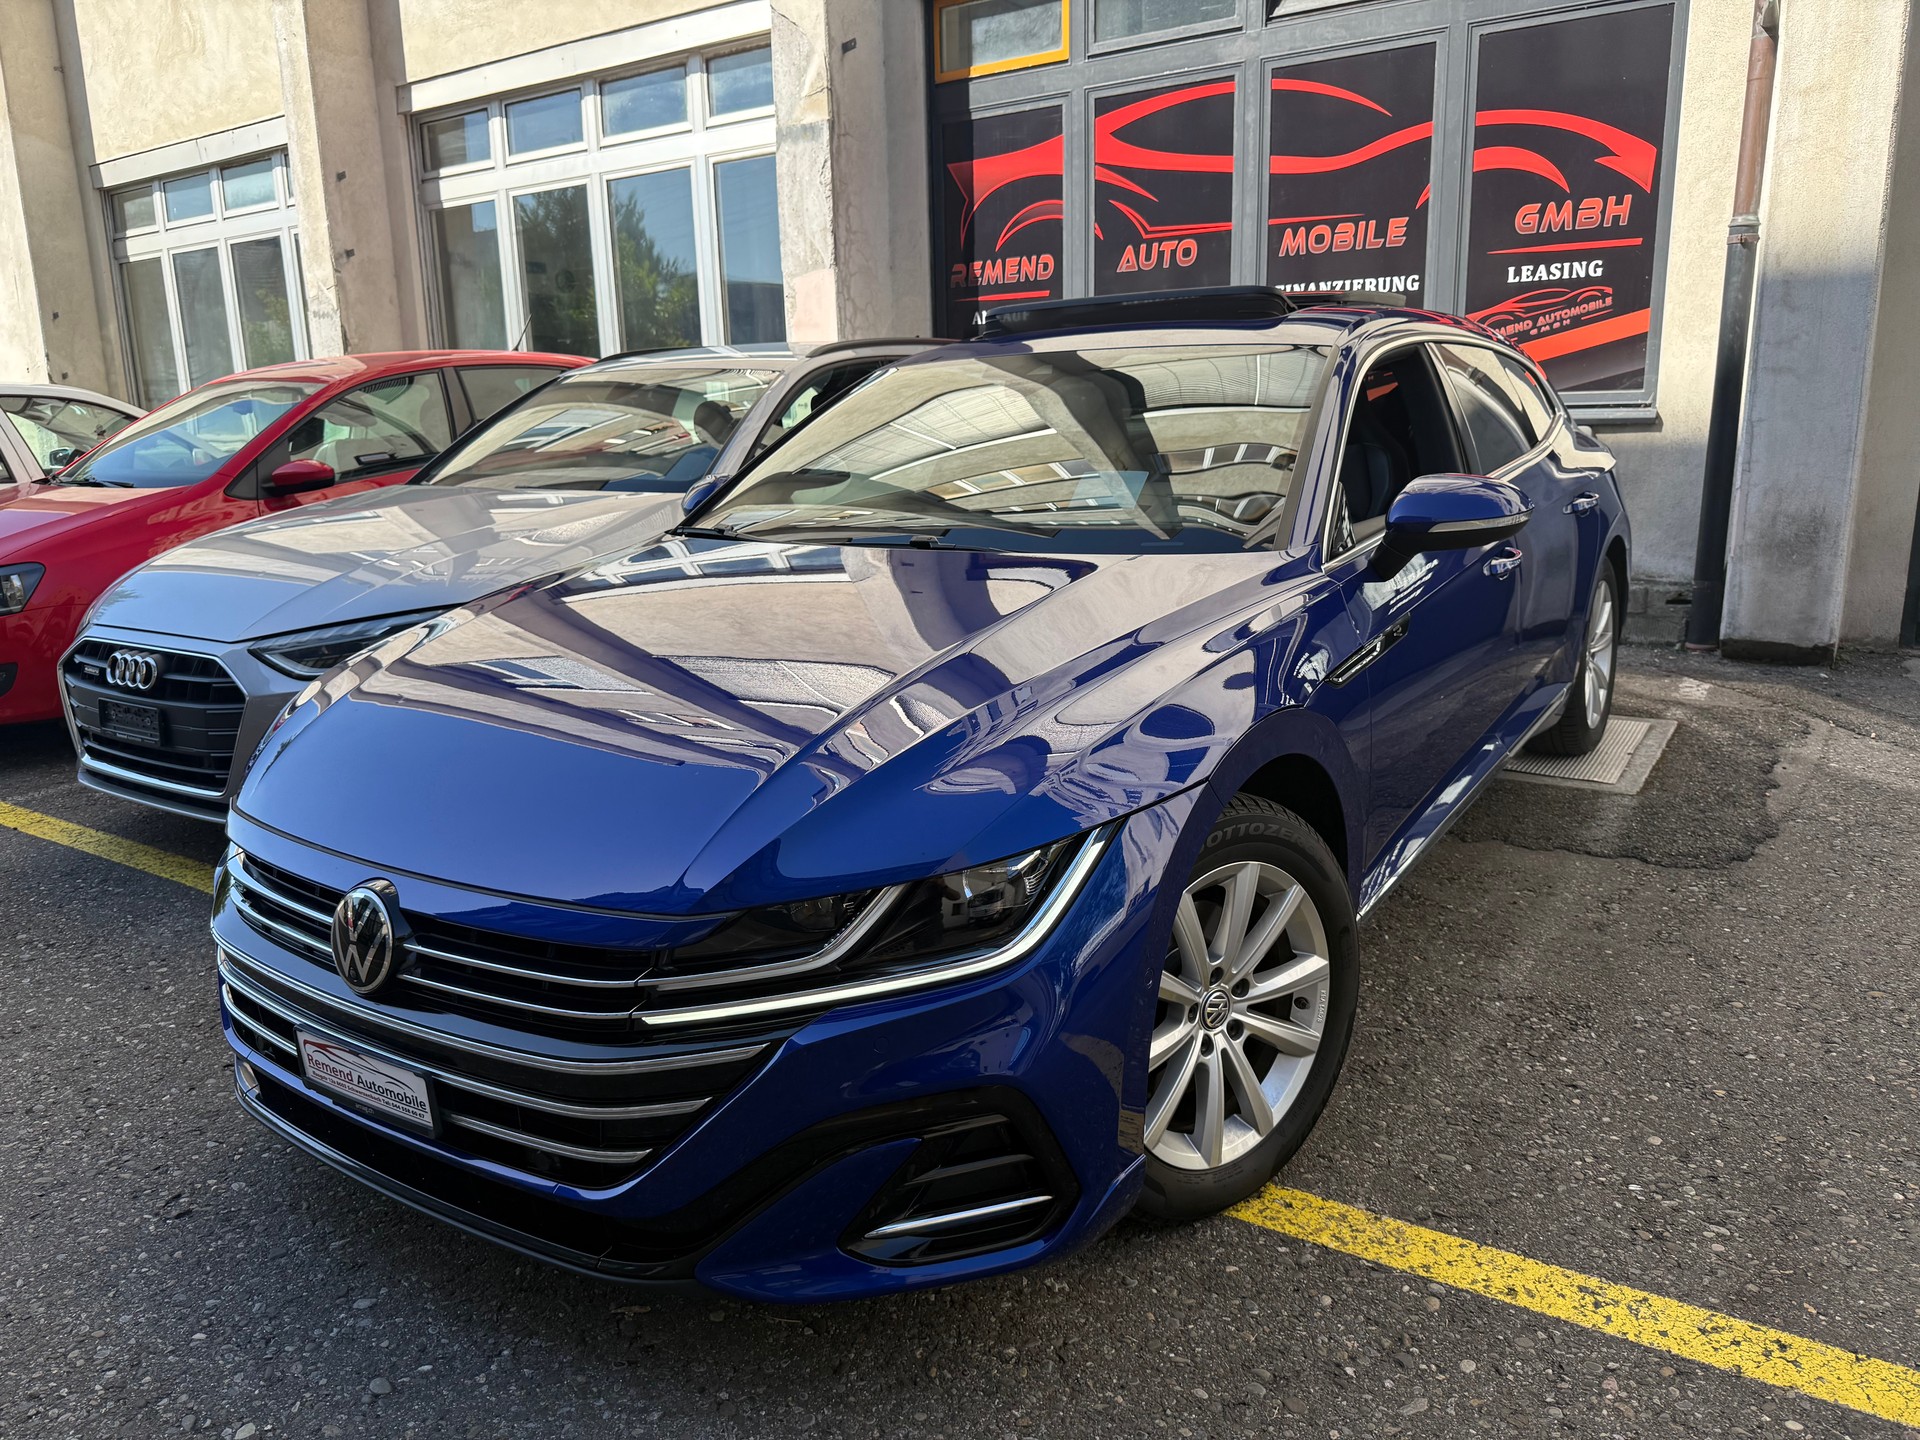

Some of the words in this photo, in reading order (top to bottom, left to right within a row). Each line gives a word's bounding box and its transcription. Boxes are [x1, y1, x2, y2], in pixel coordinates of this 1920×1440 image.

[951, 253, 1055, 288] REMEND
[1116, 238, 1198, 273] AUTO
[1278, 216, 1410, 257] MOBILE
[1513, 193, 1633, 235] GMBH
[1507, 259, 1604, 284] LEASING
[1495, 320, 1533, 337] MEND
[1536, 296, 1613, 327] AUTOMOBILE
[1201, 822, 1318, 855] OTTOZERO
[306, 1054, 354, 1082] Remend
[357, 1074, 427, 1110] Automobile
